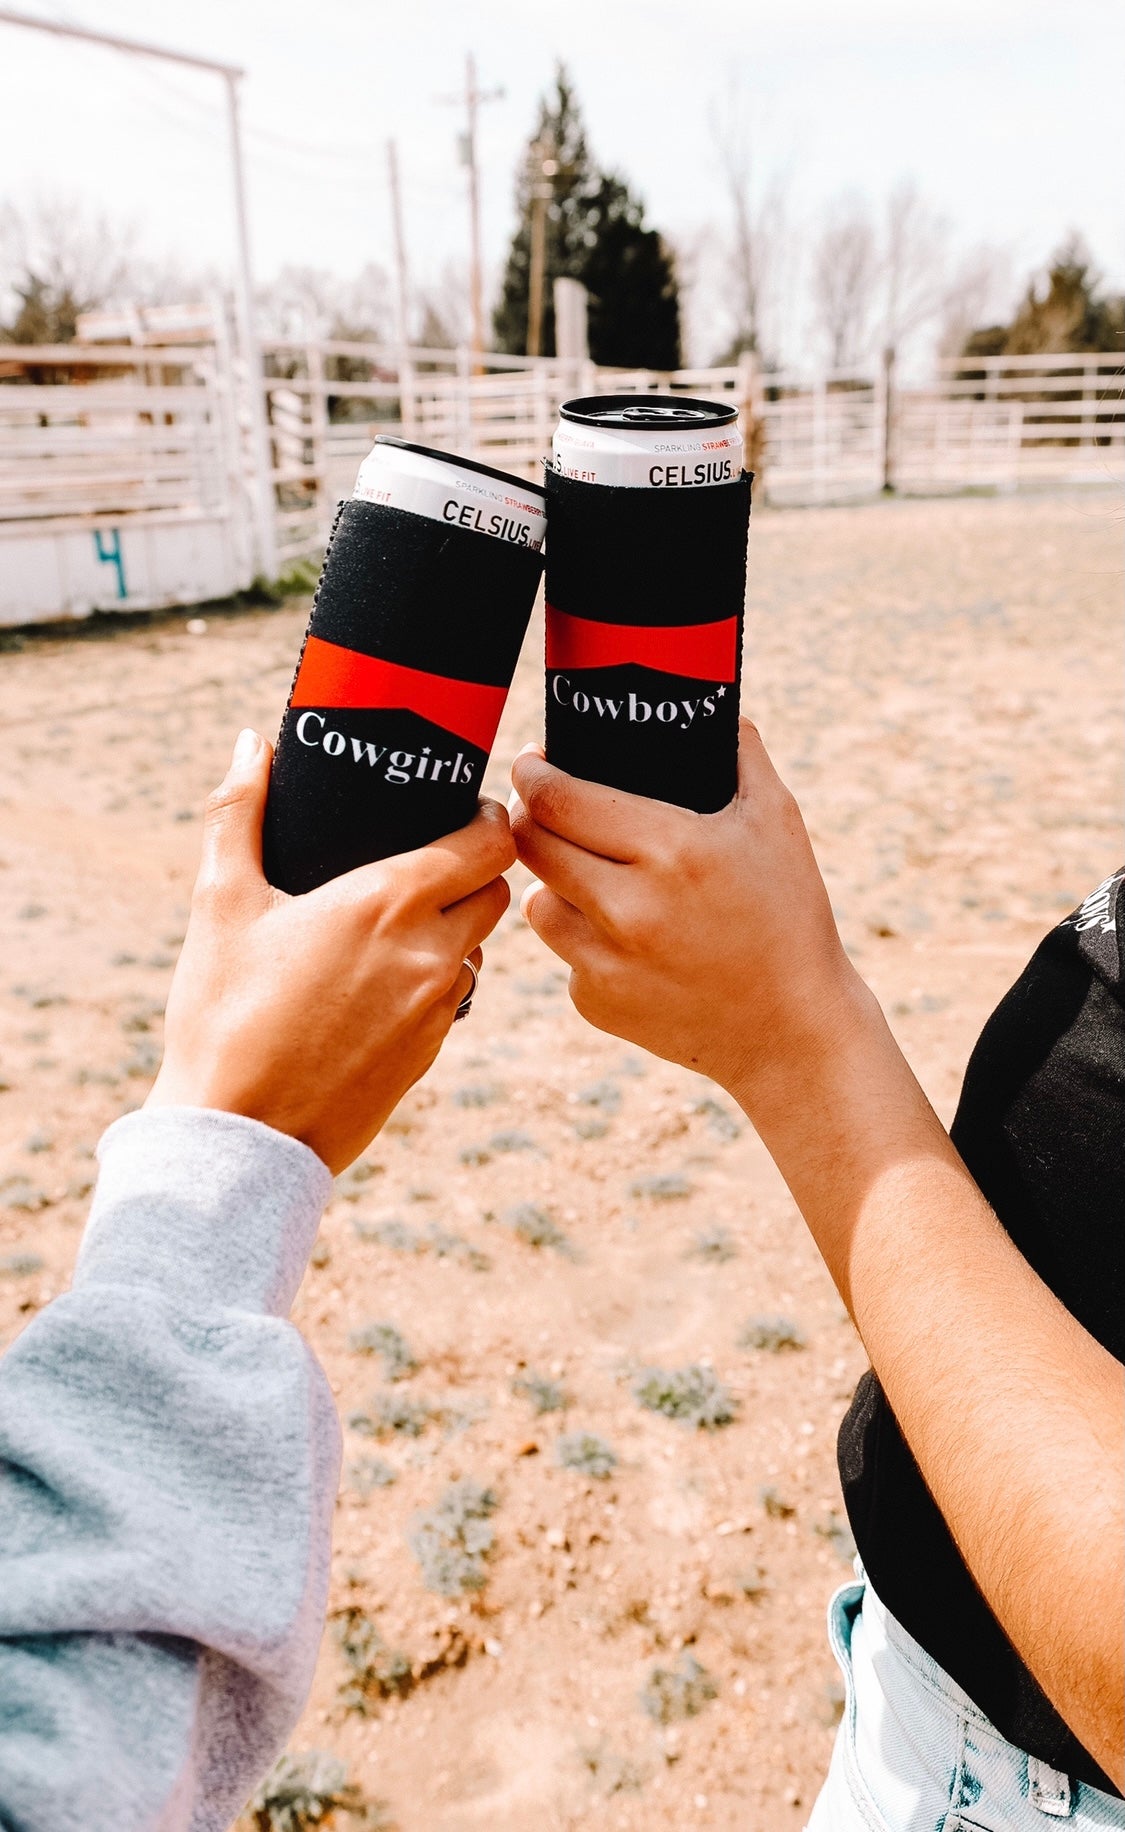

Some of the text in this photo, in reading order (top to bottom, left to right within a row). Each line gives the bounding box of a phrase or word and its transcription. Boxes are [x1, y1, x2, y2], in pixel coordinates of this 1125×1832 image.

[654, 443, 701, 453] SPARKLING
[455, 480, 504, 503] SPARKLING
[563, 466, 579, 479] LIVE
[581, 471, 596, 482] FIT
[93, 527, 127, 599] 4
[552, 674, 716, 729] Cowboys
[296, 711, 475, 785] Cowgirls
